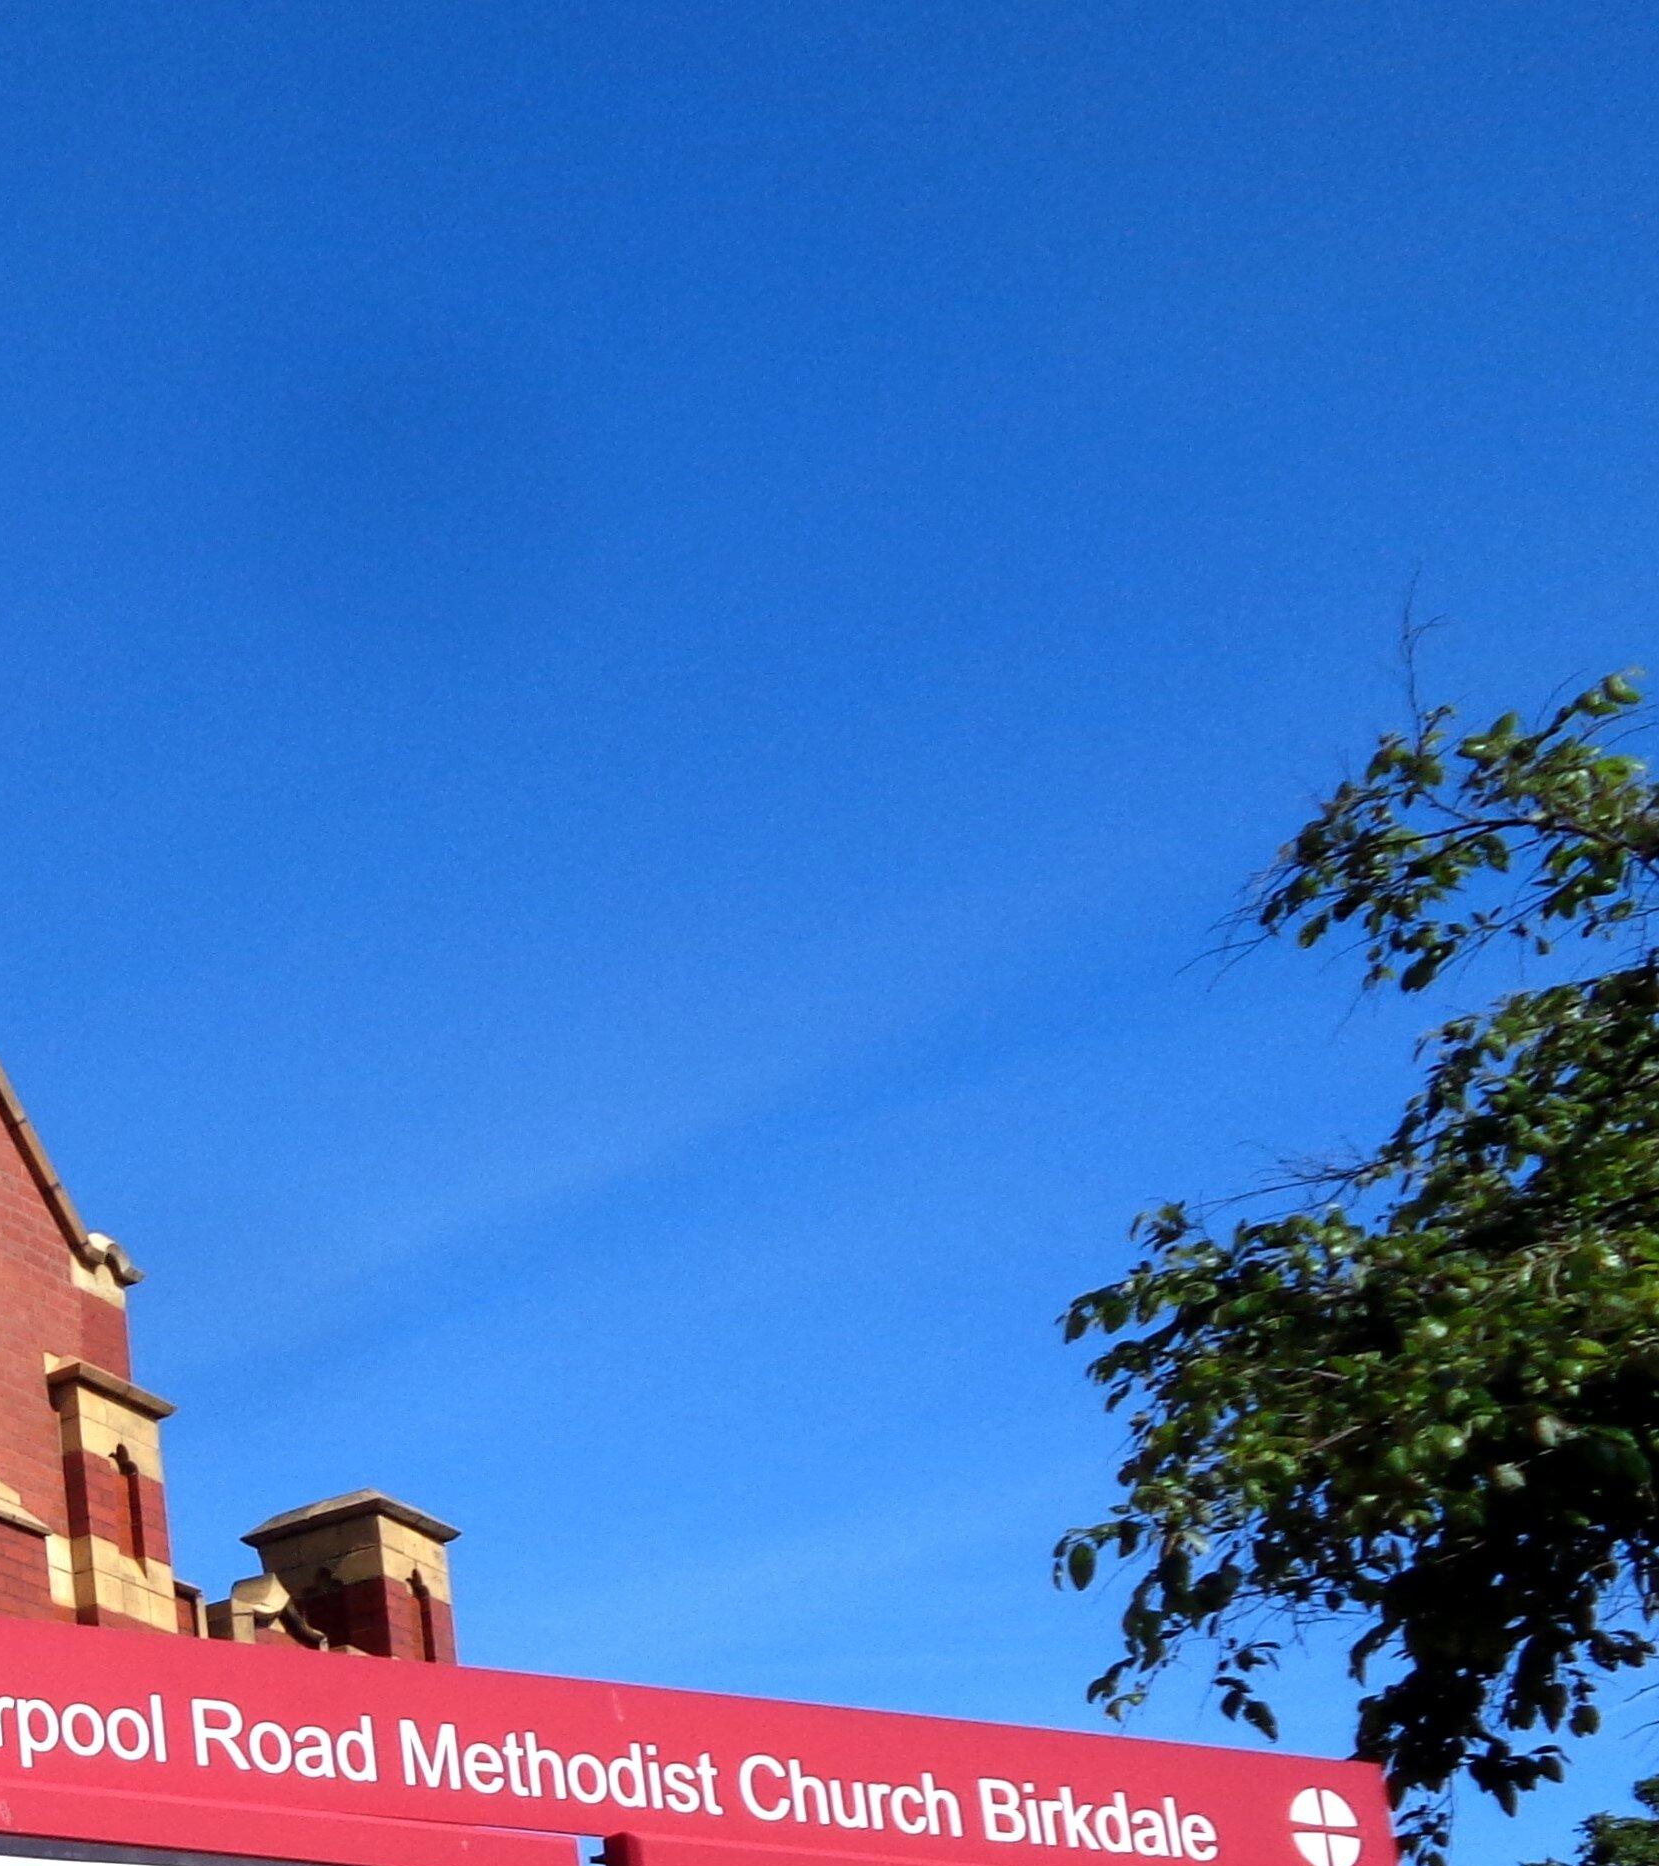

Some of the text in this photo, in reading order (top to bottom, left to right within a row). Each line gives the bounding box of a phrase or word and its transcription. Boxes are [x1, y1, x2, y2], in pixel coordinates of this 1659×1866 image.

[193, 1698, 378, 1783] Road
[399, 1719, 723, 1815] Methodist
[739, 1755, 963, 1838] Church
[979, 1775, 1217, 1863] Birkdale
